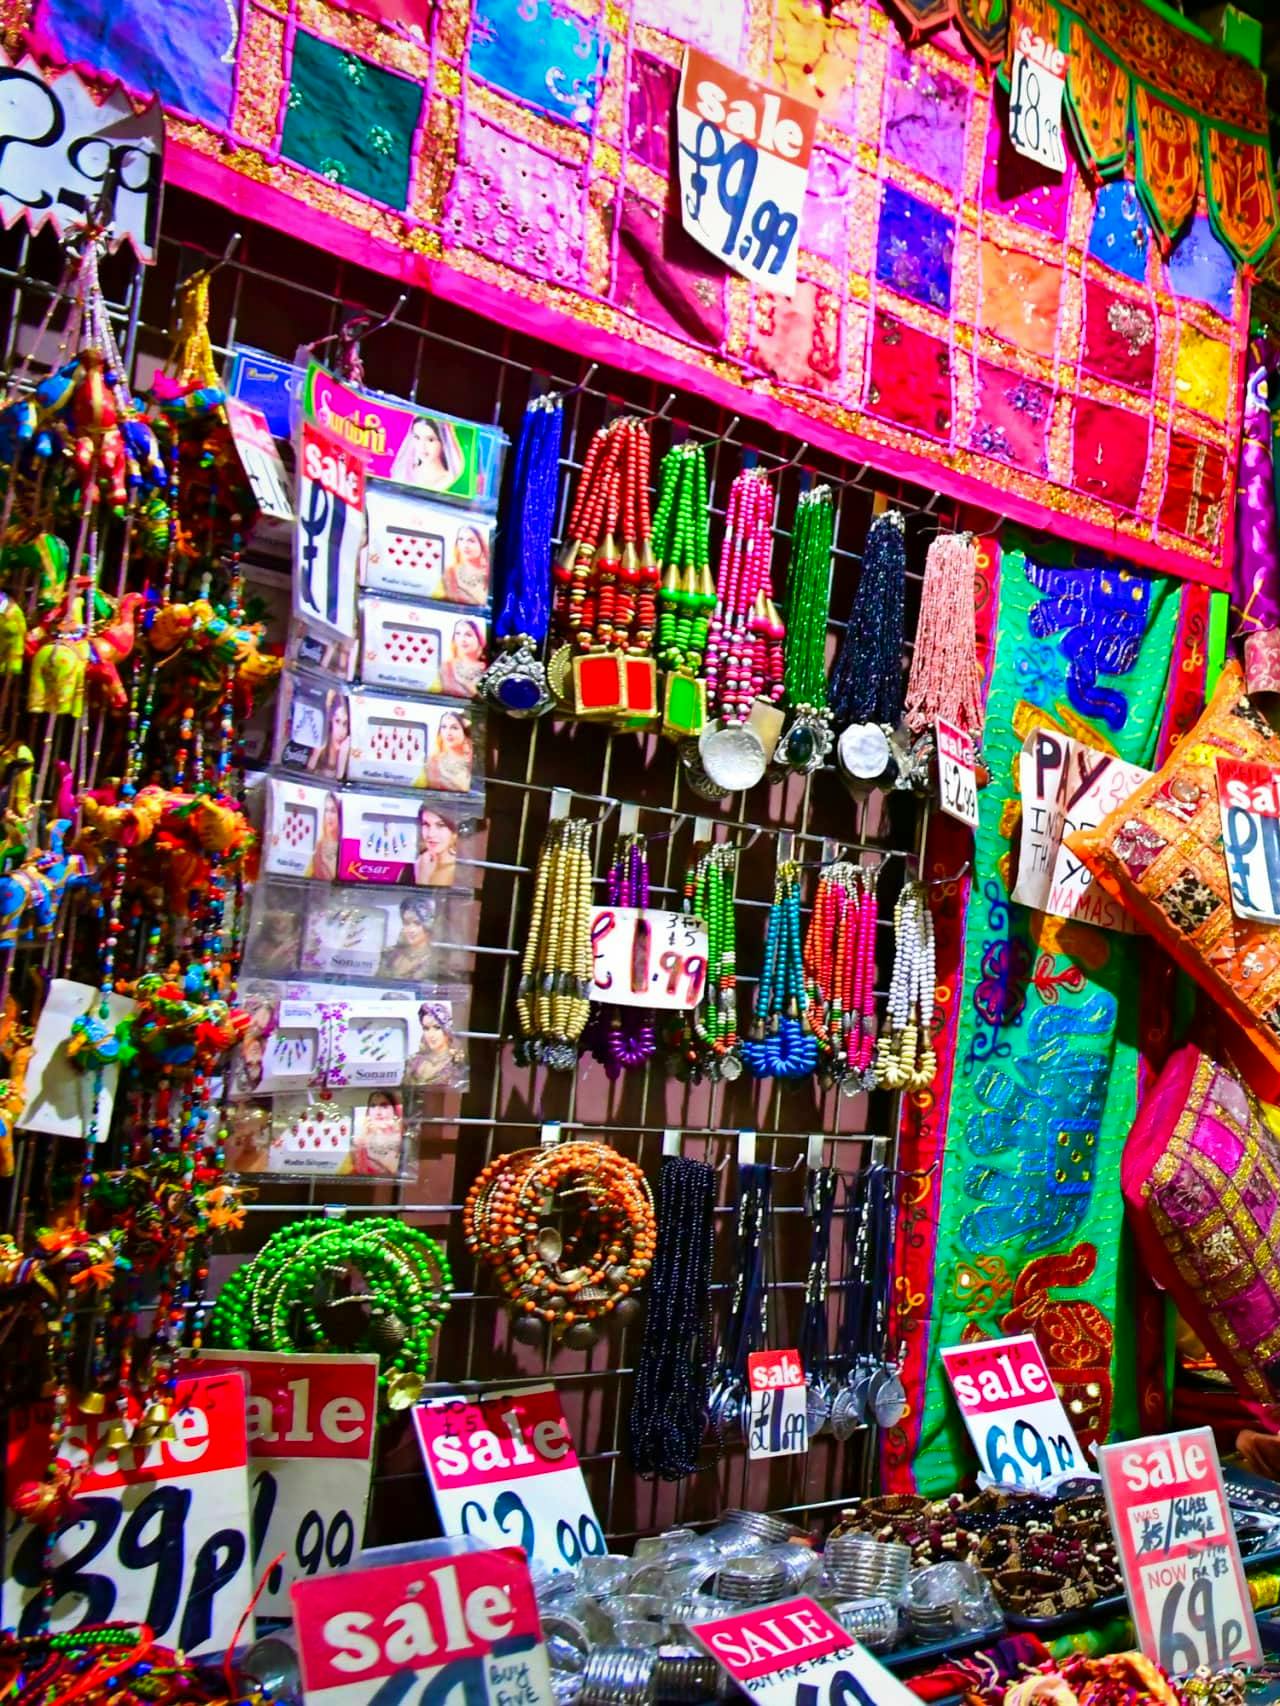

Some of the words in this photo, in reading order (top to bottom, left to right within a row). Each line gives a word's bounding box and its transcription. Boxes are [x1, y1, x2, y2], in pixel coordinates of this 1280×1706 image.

[1020, 26, 1065, 75] sale
[696, 81, 804, 158] sale
[680, 120, 799, 275] £9.99
[305, 443, 362, 502] sale
[940, 732, 975, 766] sale
[347, 861, 390, 884] Kesar
[331, 954, 373, 970] Sonam
[590, 911, 707, 1006] £1.99
[354, 1068, 398, 1080] Sonam
[753, 1355, 801, 1388] sale
[953, 1354, 1048, 1406] sale
[247, 1378, 366, 1443] ale
[751, 1391, 805, 1453] £1.99
[432, 1408, 570, 1476] sale
[986, 1420, 1075, 1484] 69p
[1121, 1437, 1208, 1492] sale
[1134, 1508, 1160, 1523] WAS
[12, 1486, 245, 1654] 89p
[1148, 1564, 1187, 1589] NOW
[323, 1565, 514, 1673] sale
[711, 1610, 834, 1667] SALE
[1159, 1578, 1242, 1676] 69p
[490, 1663, 530, 1689] BUY
